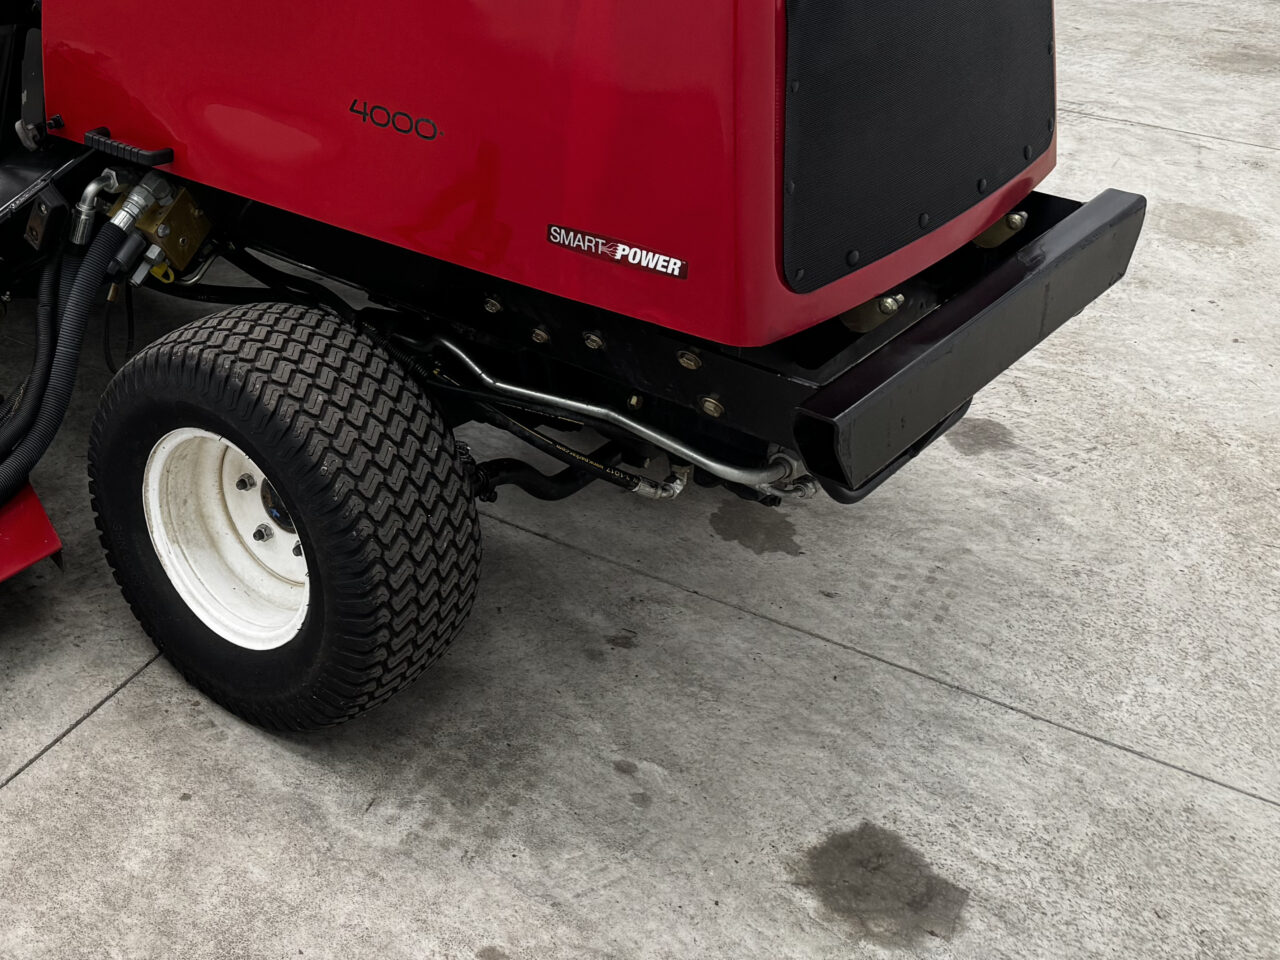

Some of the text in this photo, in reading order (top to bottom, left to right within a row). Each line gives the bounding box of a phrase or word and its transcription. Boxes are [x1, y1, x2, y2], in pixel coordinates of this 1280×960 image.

[349, 98, 438, 141] 4000
[549, 226, 682, 276] SMART POWER
